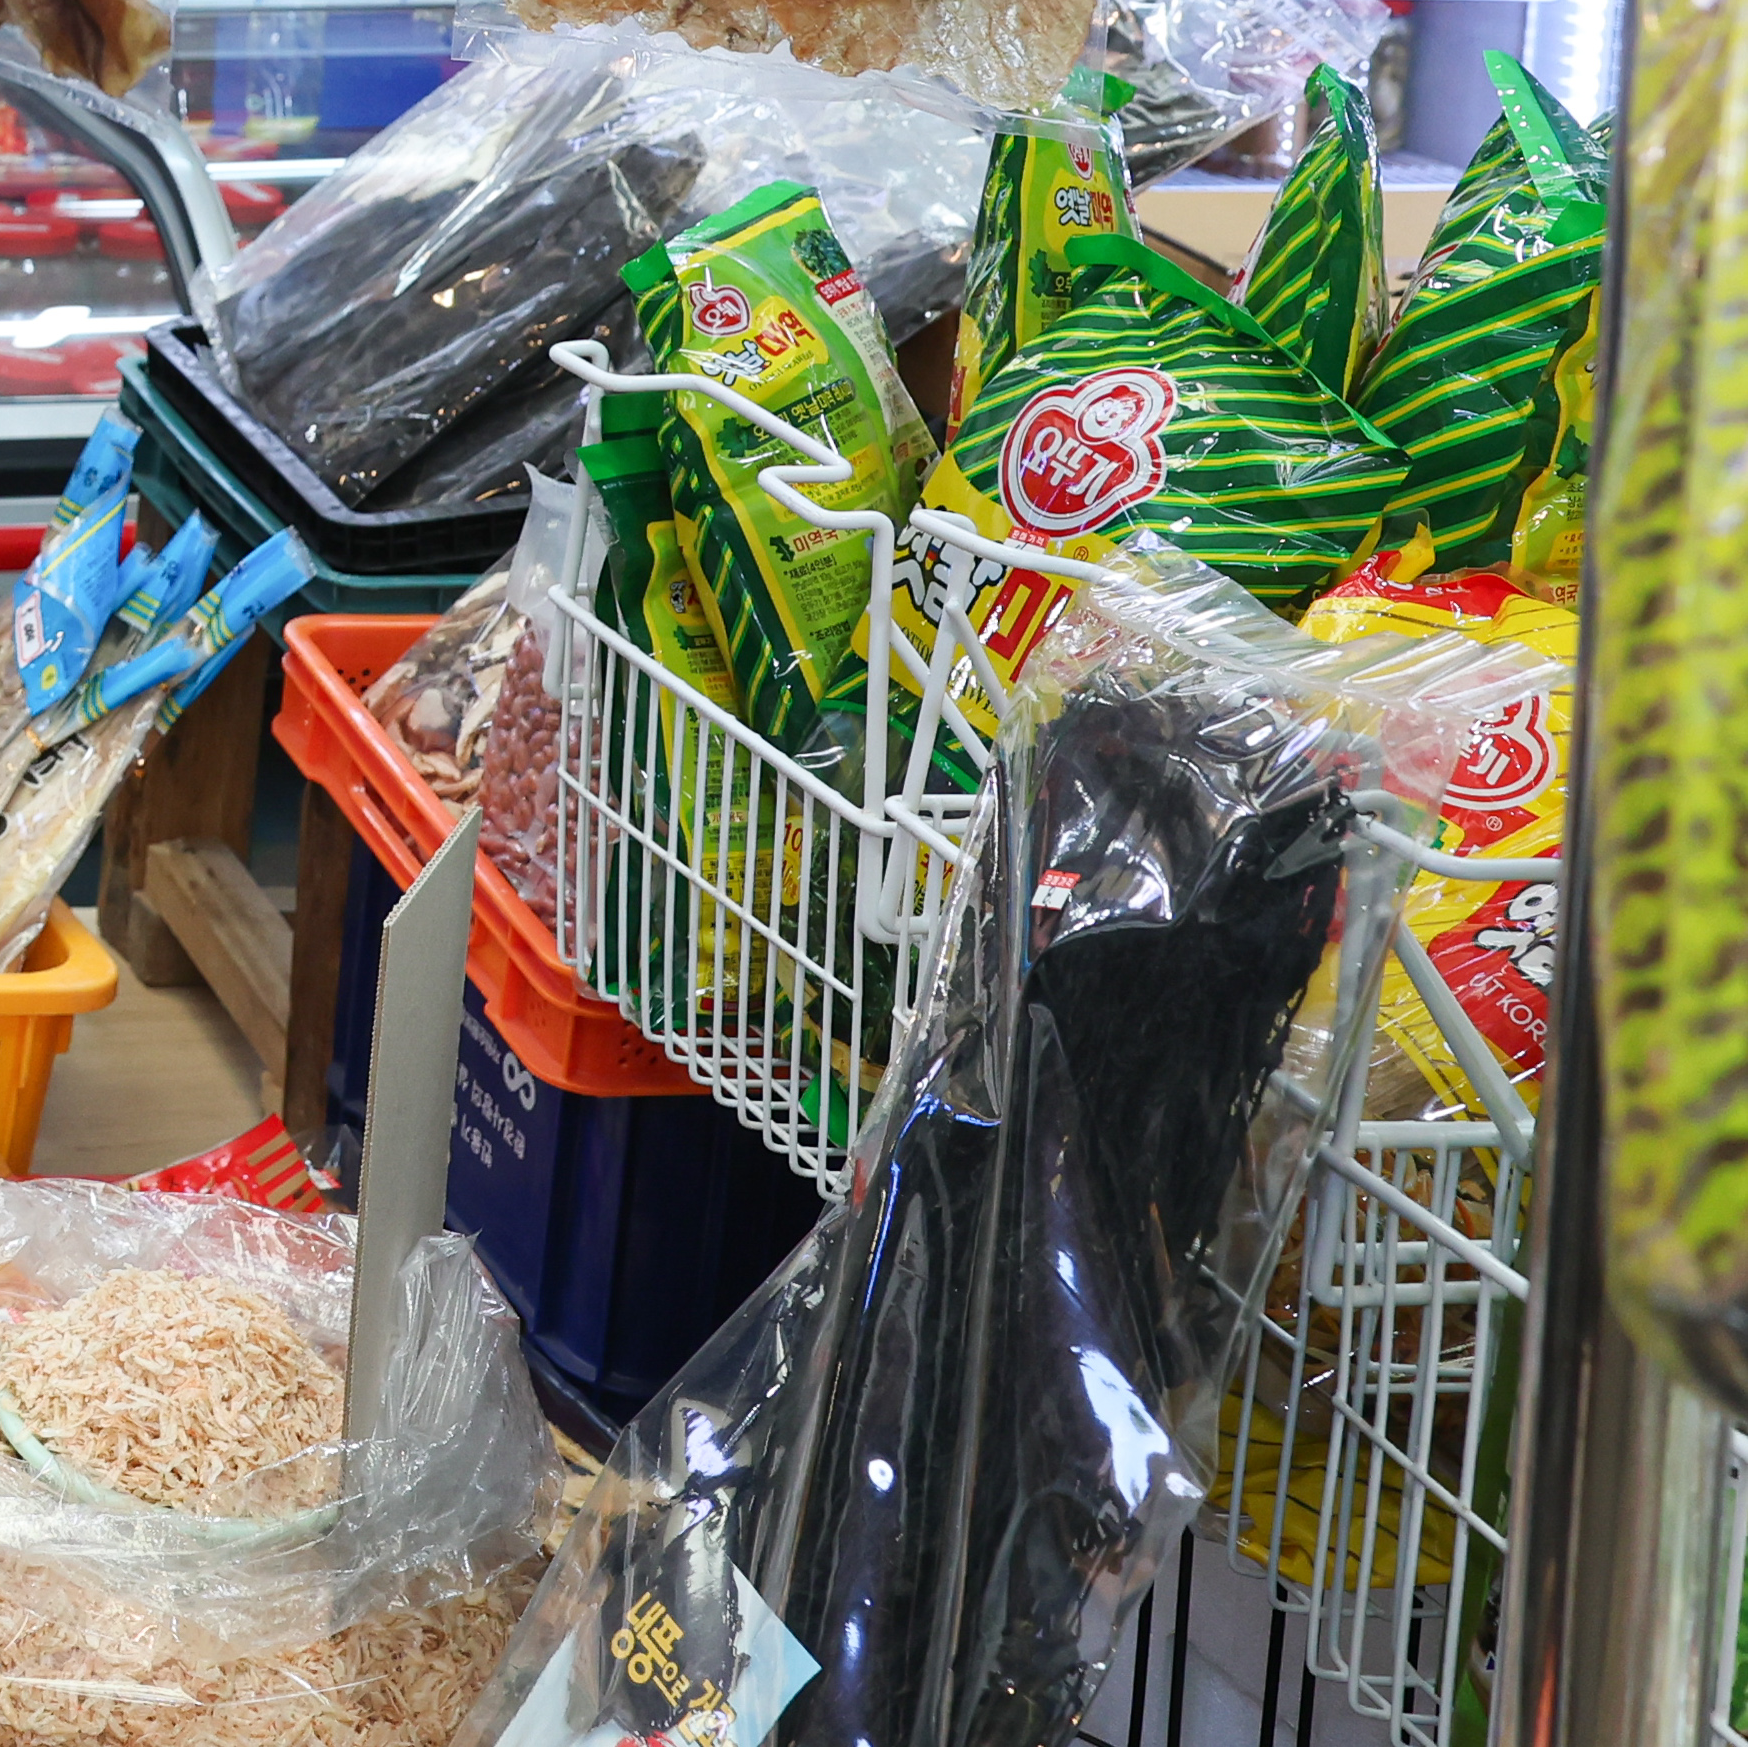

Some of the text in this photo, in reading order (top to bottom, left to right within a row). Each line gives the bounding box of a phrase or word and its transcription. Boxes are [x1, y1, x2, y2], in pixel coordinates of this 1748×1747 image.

[1054, 186, 1092, 227] 옛날
[754, 307, 816, 358] 미역
[1020, 424, 1121, 507] 오뚜기
[793, 526, 840, 554] 미역국
[610, 1590, 692, 1708] 냉풍으로
